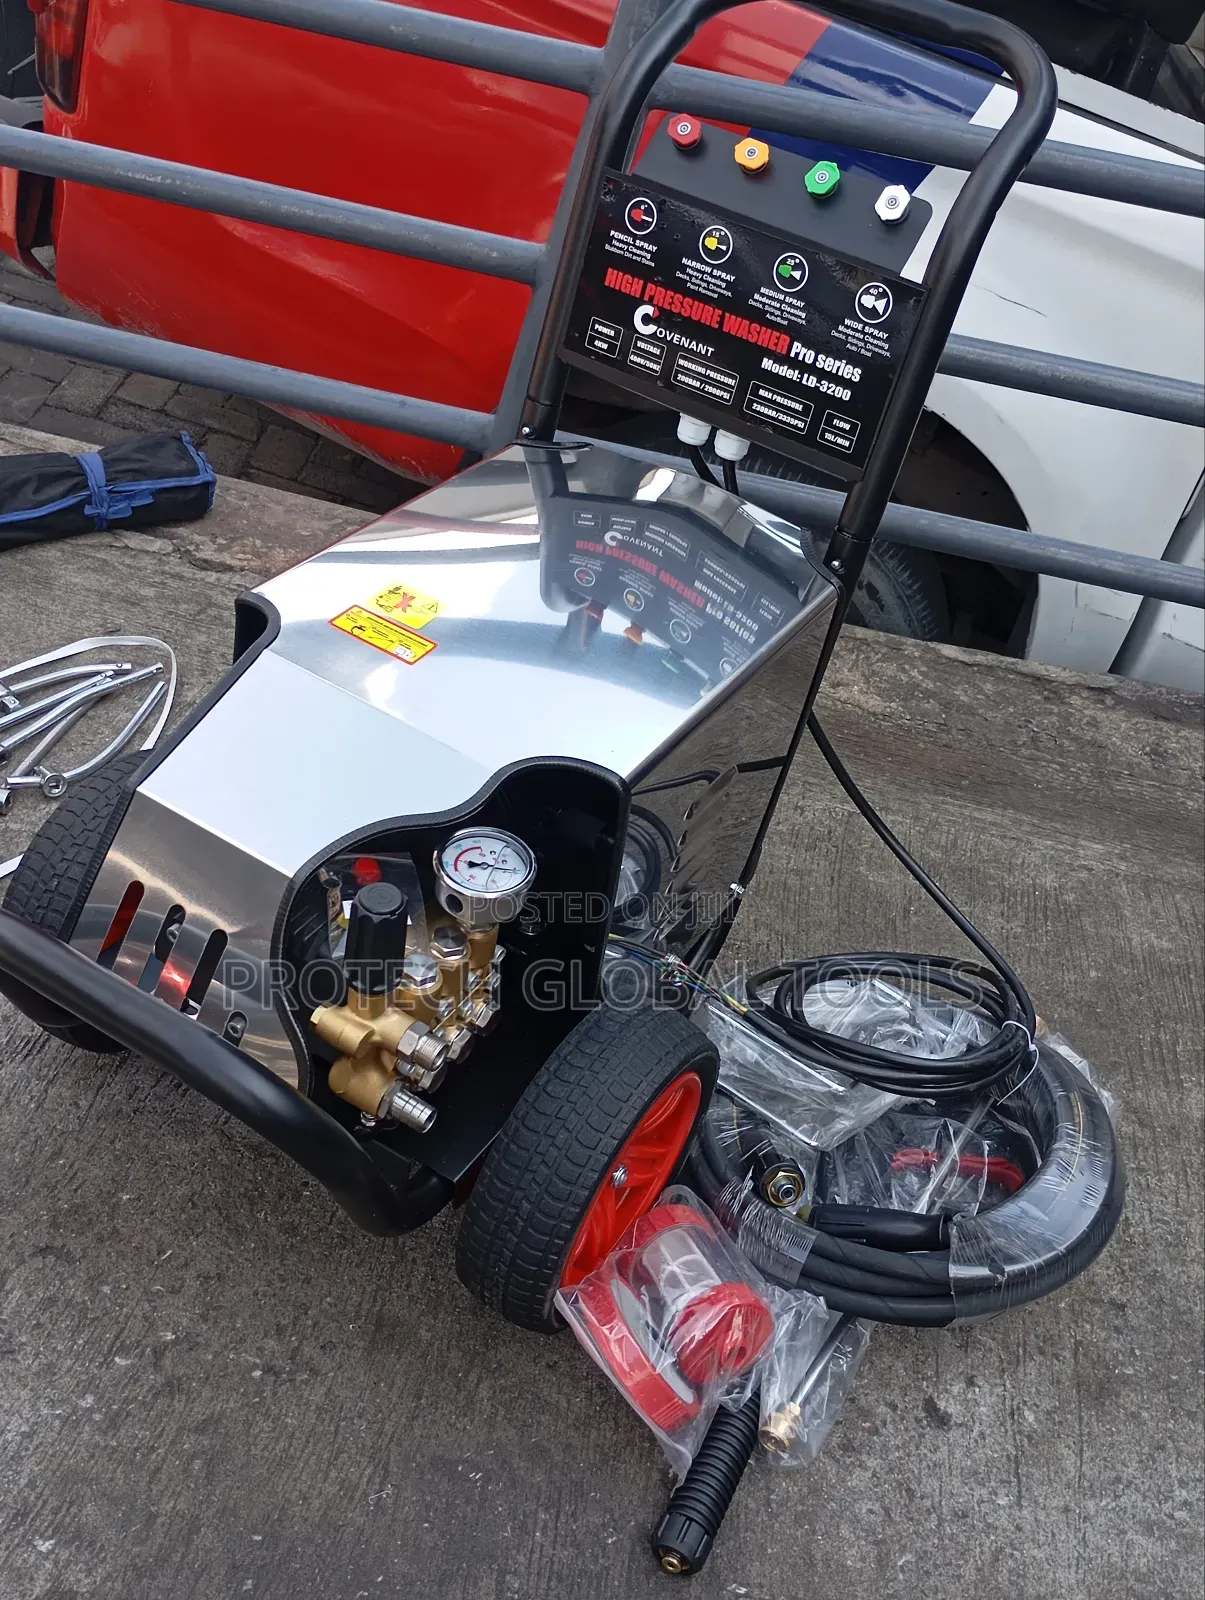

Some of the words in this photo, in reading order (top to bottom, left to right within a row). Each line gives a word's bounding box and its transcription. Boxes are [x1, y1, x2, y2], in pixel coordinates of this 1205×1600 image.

[609, 229, 634, 245] PENCIL
[634, 239, 658, 253] SPRAY
[611, 239, 629, 251] Heavy
[628, 245, 652, 260] Cleaning
[681, 257, 712, 274] NARROW
[712, 268, 736, 283] SPRAY
[685, 267, 703, 280] Heavy
[702, 273, 727, 289] Cleaning
[686, 281, 699, 292] Paint
[698, 286, 719, 299] Removal
[760, 286, 785, 301] MEDIUM
[784, 296, 806, 309] SPRAY
[753, 292, 781, 309] Moderate
[780, 303, 807, 319] Cleaning
[594, 323, 616, 338] POWER
[604, 267, 645, 299] HIGH
[643, 282, 723, 329] PRESSURE
[722, 312, 791, 356] WASHER
[789, 340, 816, 365] Pro
[815, 353, 863, 384] series
[633, 304, 715, 358] COVENANT
[837, 324, 864, 340] Moderate
[864, 334, 889, 350] Cleaning
[844, 317, 864, 331] WIDE
[863, 325, 889, 340] SPRAY
[593, 339, 609, 351] 4KW
[636, 340, 662, 356] VOLTAGE
[845, 343, 858, 352] Auto
[676, 373, 701, 388] 200BAR
[678, 358, 707, 375] WORKING
[705, 369, 737, 387] PRESSURE
[760, 357, 802, 383] Model:
[801, 372, 852, 402] LD-3200
[758, 388, 773, 400] MAX
[772, 394, 804, 412] PRESSURE
[751, 402, 806, 430] 230BAR/3335PSI
[832, 418, 852, 432] FLOW
[824, 432, 851, 448] 15L/MIN
